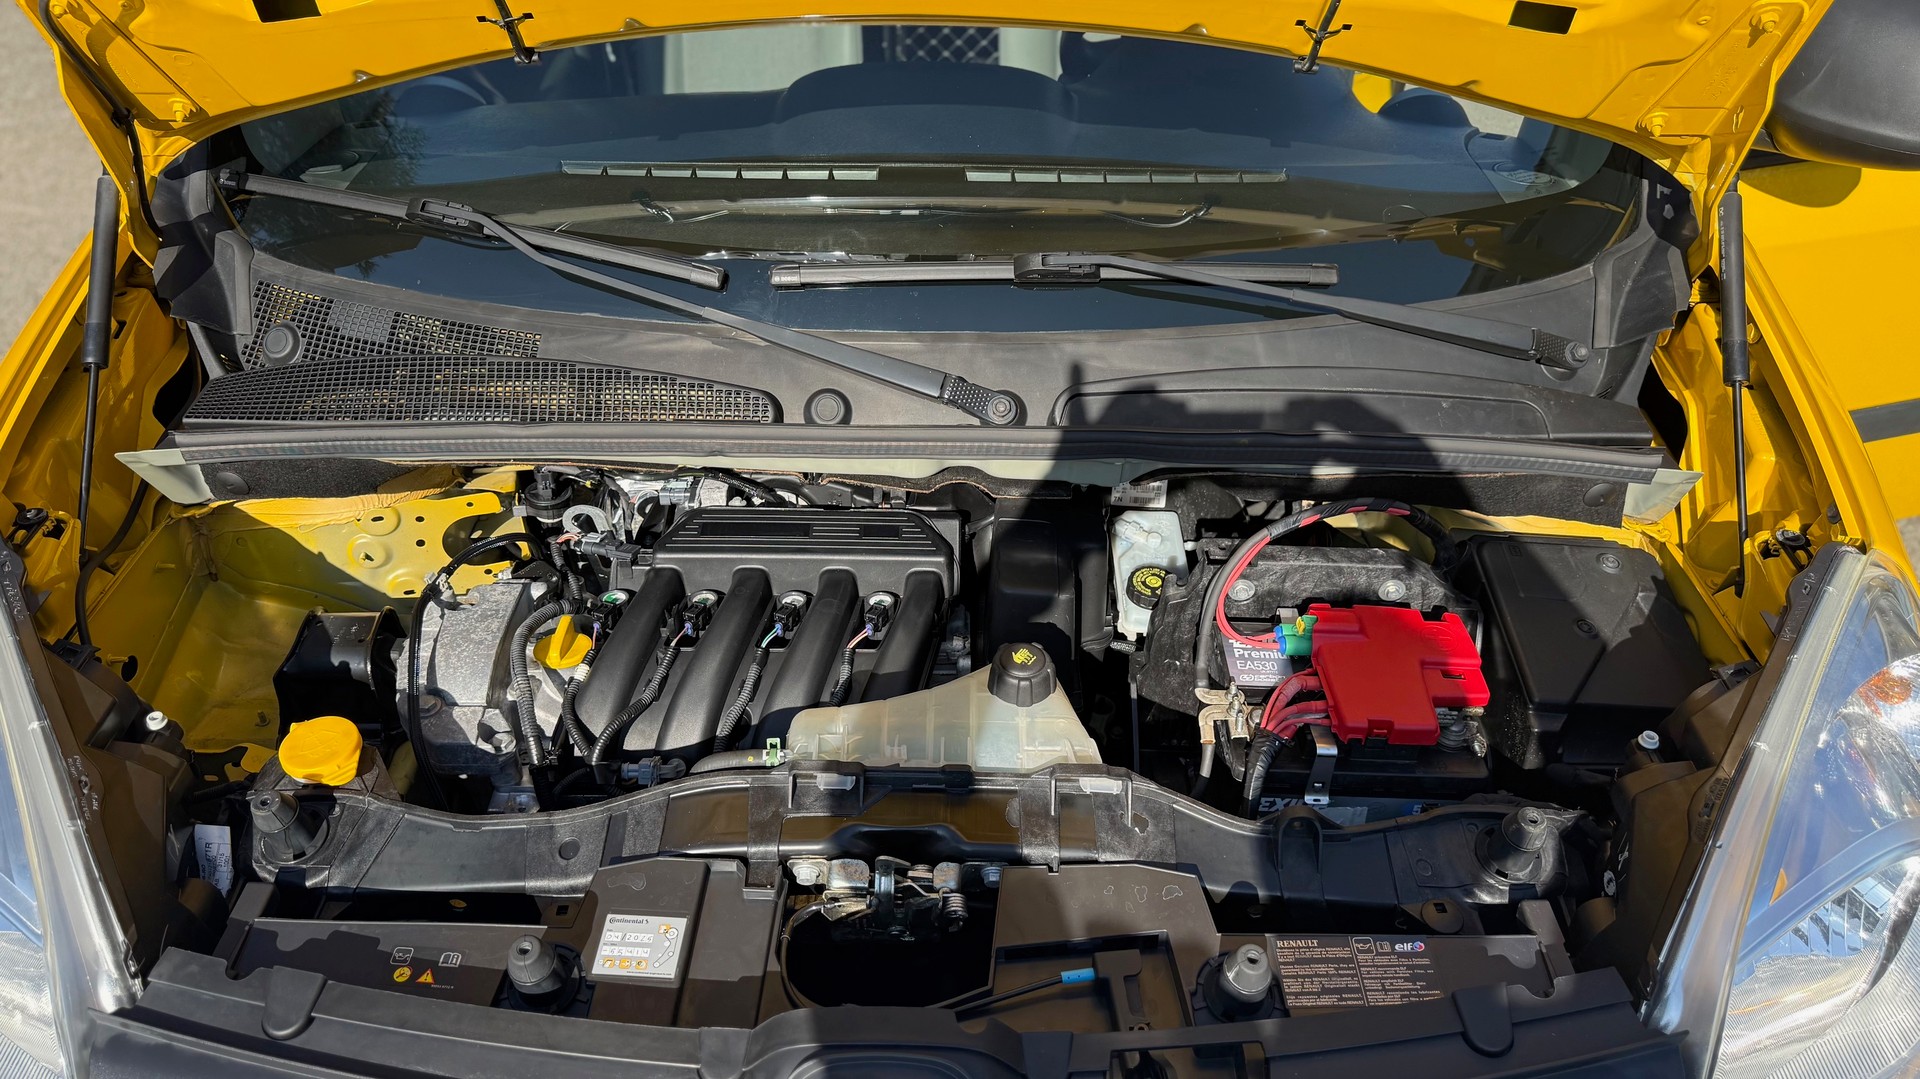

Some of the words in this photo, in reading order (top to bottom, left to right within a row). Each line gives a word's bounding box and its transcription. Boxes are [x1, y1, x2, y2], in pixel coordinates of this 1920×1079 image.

[1234, 648, 1290, 660] Premiu
[1236, 660, 1278, 671] EA530
[609, 916, 644, 925] Continental
[1394, 942, 1413, 951] elf
